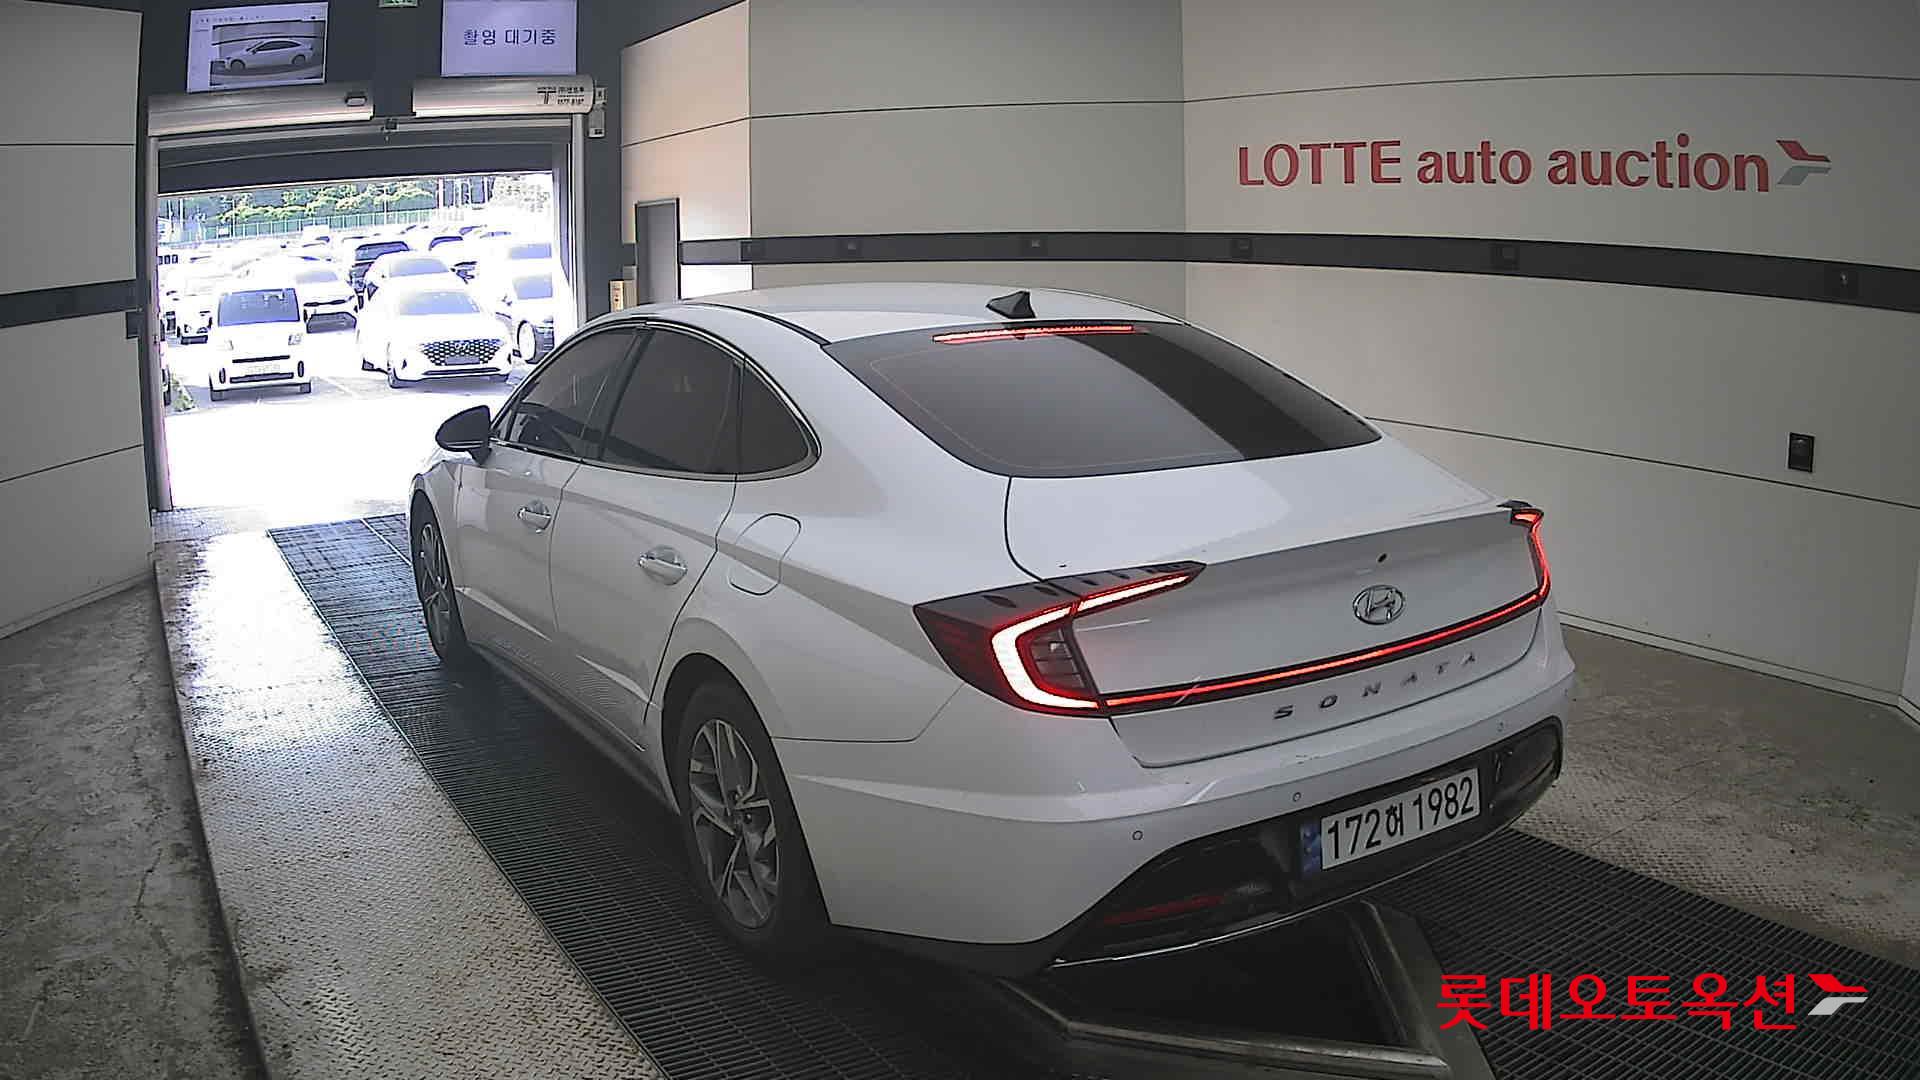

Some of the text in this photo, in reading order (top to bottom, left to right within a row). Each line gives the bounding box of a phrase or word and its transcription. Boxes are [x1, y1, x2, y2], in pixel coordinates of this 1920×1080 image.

[464, 28, 556, 45] 촬영 대기중
[1239, 133, 1769, 192] LOTTE auto auction
[1273, 652, 1476, 720] SONATA
[1327, 777, 1475, 860] 172허 1982
